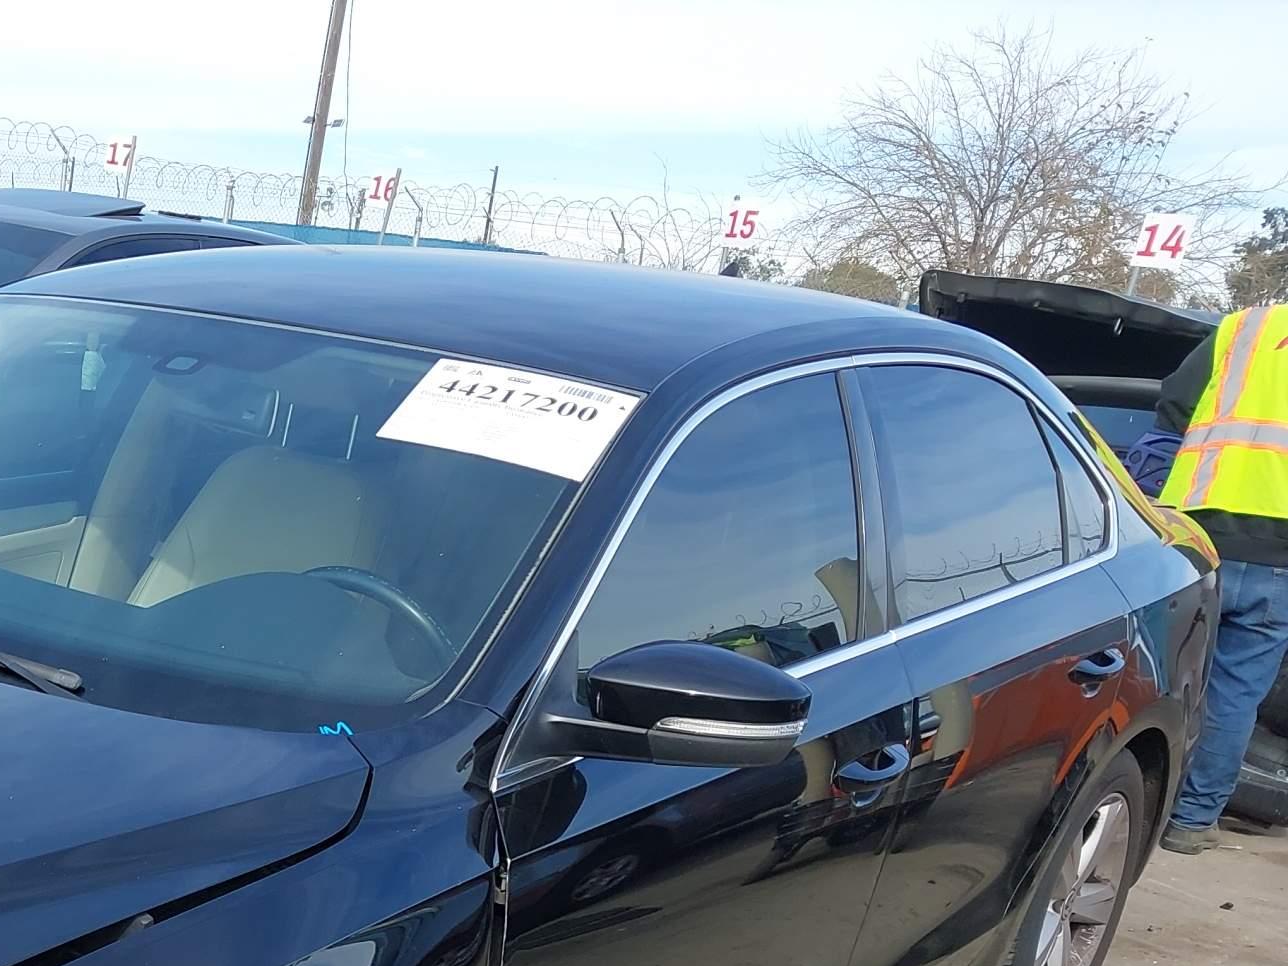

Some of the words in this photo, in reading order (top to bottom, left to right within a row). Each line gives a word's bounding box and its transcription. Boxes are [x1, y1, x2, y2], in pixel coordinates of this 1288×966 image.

[106, 142, 135, 167] 17
[724, 209, 759, 239] 15
[1135, 223, 1186, 259] 14
[439, 379, 599, 422] 44217200
